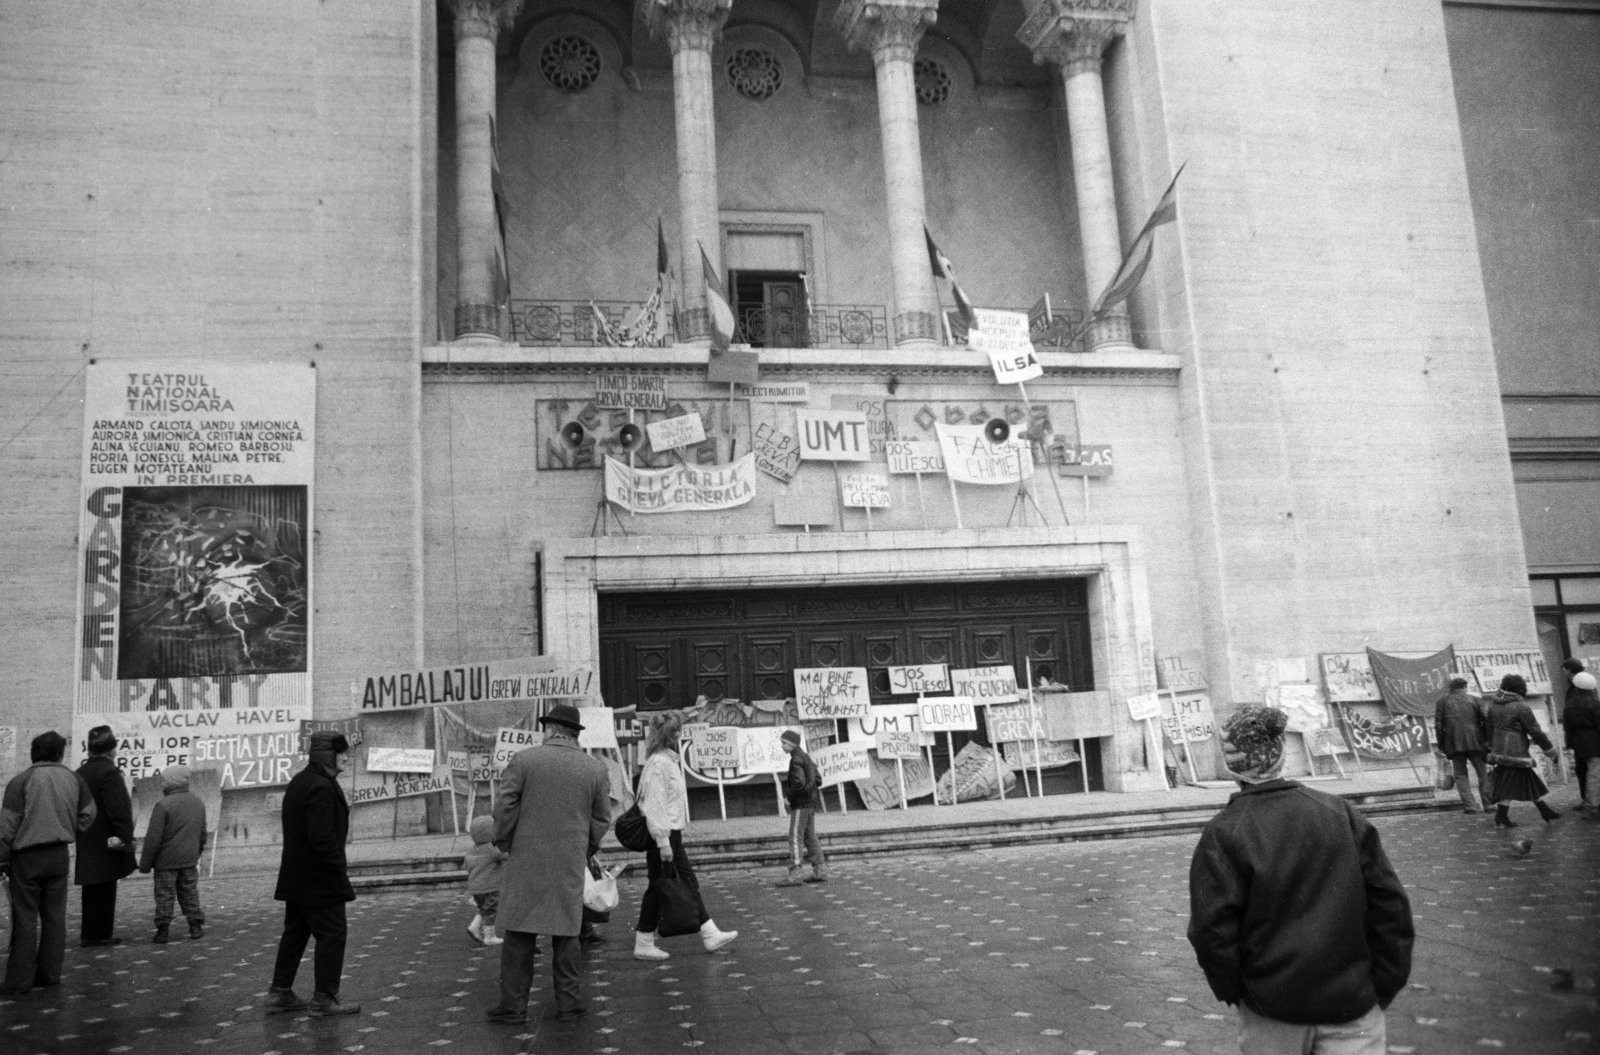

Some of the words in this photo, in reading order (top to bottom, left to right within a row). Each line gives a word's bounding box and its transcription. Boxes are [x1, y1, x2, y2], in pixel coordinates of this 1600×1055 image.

[128, 374, 208, 386] TEATRUL
[93, 421, 144, 431] ARMAND
[200, 421, 235, 431] SANDU
[92, 431, 138, 441] AURORA
[207, 431, 253, 441] CRISTIAN
[805, 420, 865, 451] UMT
[92, 442, 123, 452] ALINA
[189, 442, 233, 451] ROMEO
[888, 442, 913, 456] JOS
[90, 453, 128, 463] HORIA
[894, 455, 945, 471] ILIESCU
[90, 464, 127, 474] EUGEN
[167, 474, 255, 485] PREMIERA
[674, 479, 752, 504] GENERALA
[851, 491, 892, 506] GREVA
[81, 486, 121, 681] GARDEN
[801, 672, 822, 684] MAI
[828, 671, 853, 684] BINE
[895, 668, 924, 688] JOS
[119, 674, 268, 712] PARTY
[819, 684, 859, 698] MORT
[236, 709, 296, 725] HAVEL
[859, 715, 918, 735] UMT
[998, 720, 1046, 740] GREVA
[500, 731, 533, 746] ELBA
[706, 732, 727, 743] JOS
[890, 732, 911, 743] JOS
[166, 754, 189, 766] PE
[220, 757, 293, 788] AZUR
